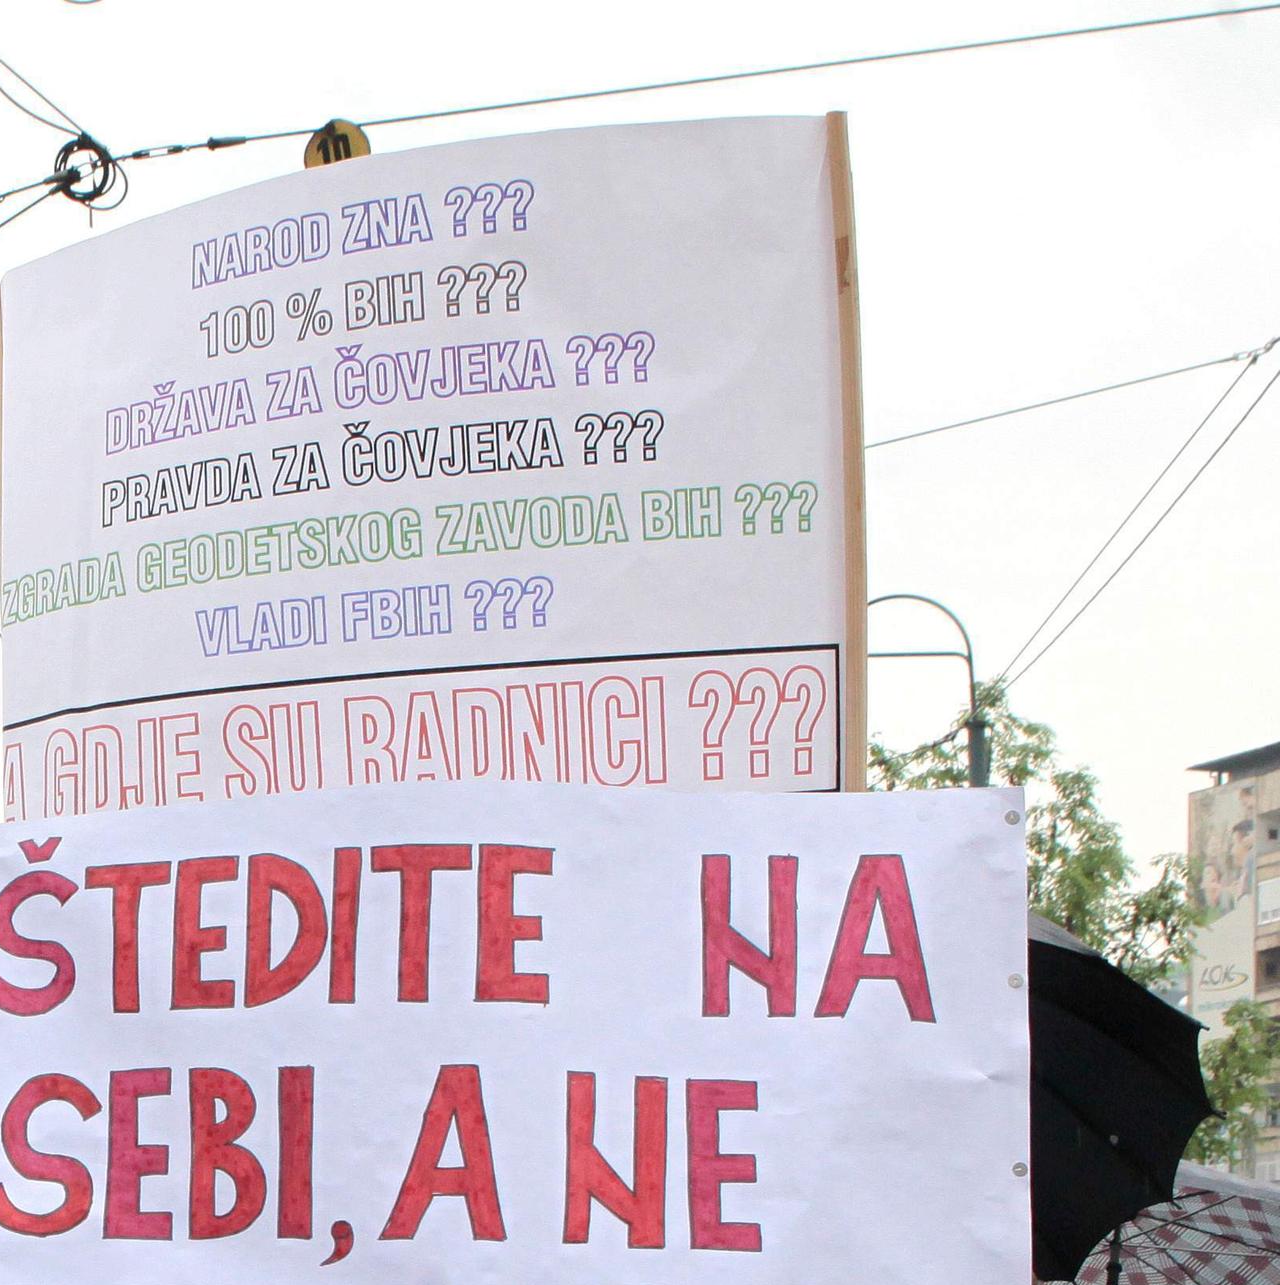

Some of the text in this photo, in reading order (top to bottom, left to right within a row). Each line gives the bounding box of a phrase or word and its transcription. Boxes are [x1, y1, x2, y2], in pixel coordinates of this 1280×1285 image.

[191, 179, 535, 290] NAROD ZNA ???
[199, 261, 527, 358] 100 % BIH ???
[106, 331, 655, 457] DRŽAVA ZA ČOVJEKA ???
[101, 410, 665, 528] PRAVDA ZA ČOVJEKA ???
[3, 481, 818, 628] ZGRADA GEODETSKOG ZAVODA BIH ???
[195, 576, 554, 659] VLADI FBIH ???
[44, 713, 204, 818] GDJE
[223, 702, 323, 798] SU
[344, 676, 667, 787] RADNICI
[689, 665, 826, 781] ???
[700, 853, 935, 1023] NA
[563, 1070, 763, 1253] NE
